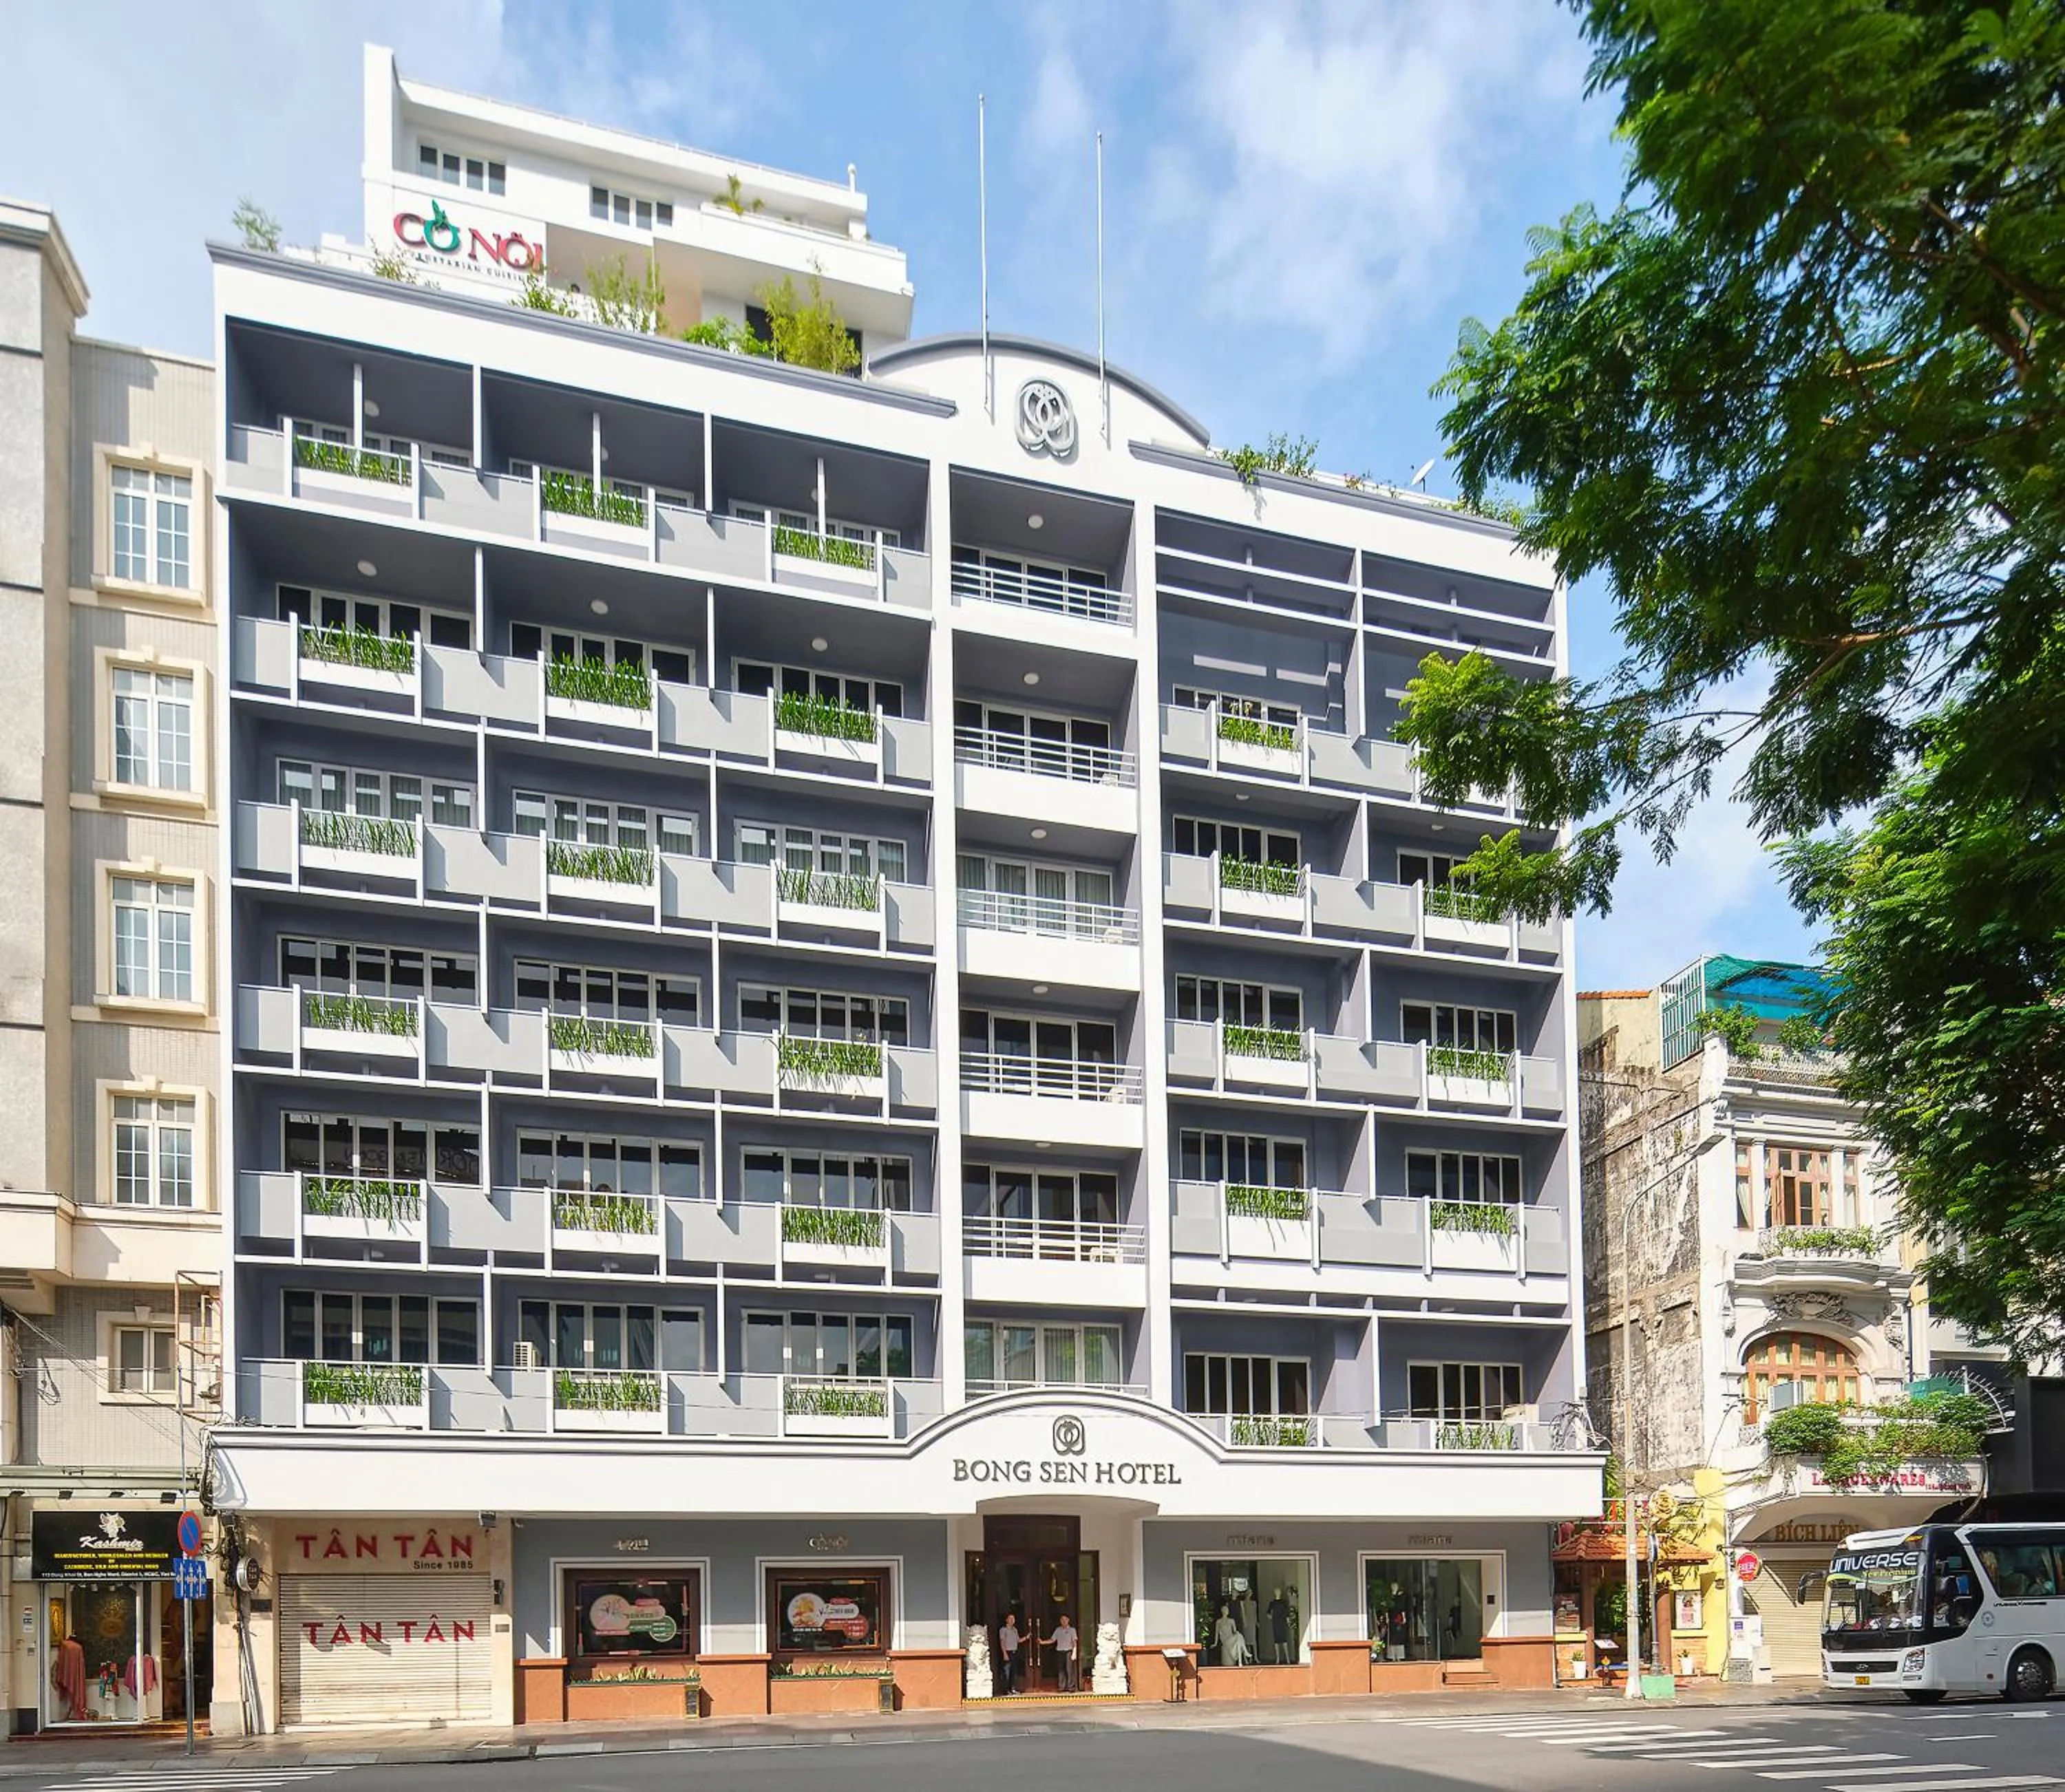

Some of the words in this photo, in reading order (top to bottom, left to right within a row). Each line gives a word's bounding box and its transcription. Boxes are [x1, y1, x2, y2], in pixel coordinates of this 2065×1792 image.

[953, 1459, 1032, 1483] BONG
[1039, 1461, 1088, 1483] SEN
[1095, 1462, 1182, 1484] HOTEL
[79, 1535, 143, 1548] Kashmir
[1775, 1519, 1817, 1542] BÍCH
[295, 1528, 378, 1559] TÂN
[394, 1528, 474, 1559] TÂN
[413, 1560, 443, 1570] Since
[447, 1560, 474, 1570] 1985
[1829, 1551, 1919, 1573] UNIVERSE
[302, 1614, 383, 1645] TÂN
[396, 1614, 474, 1643] TÂN
